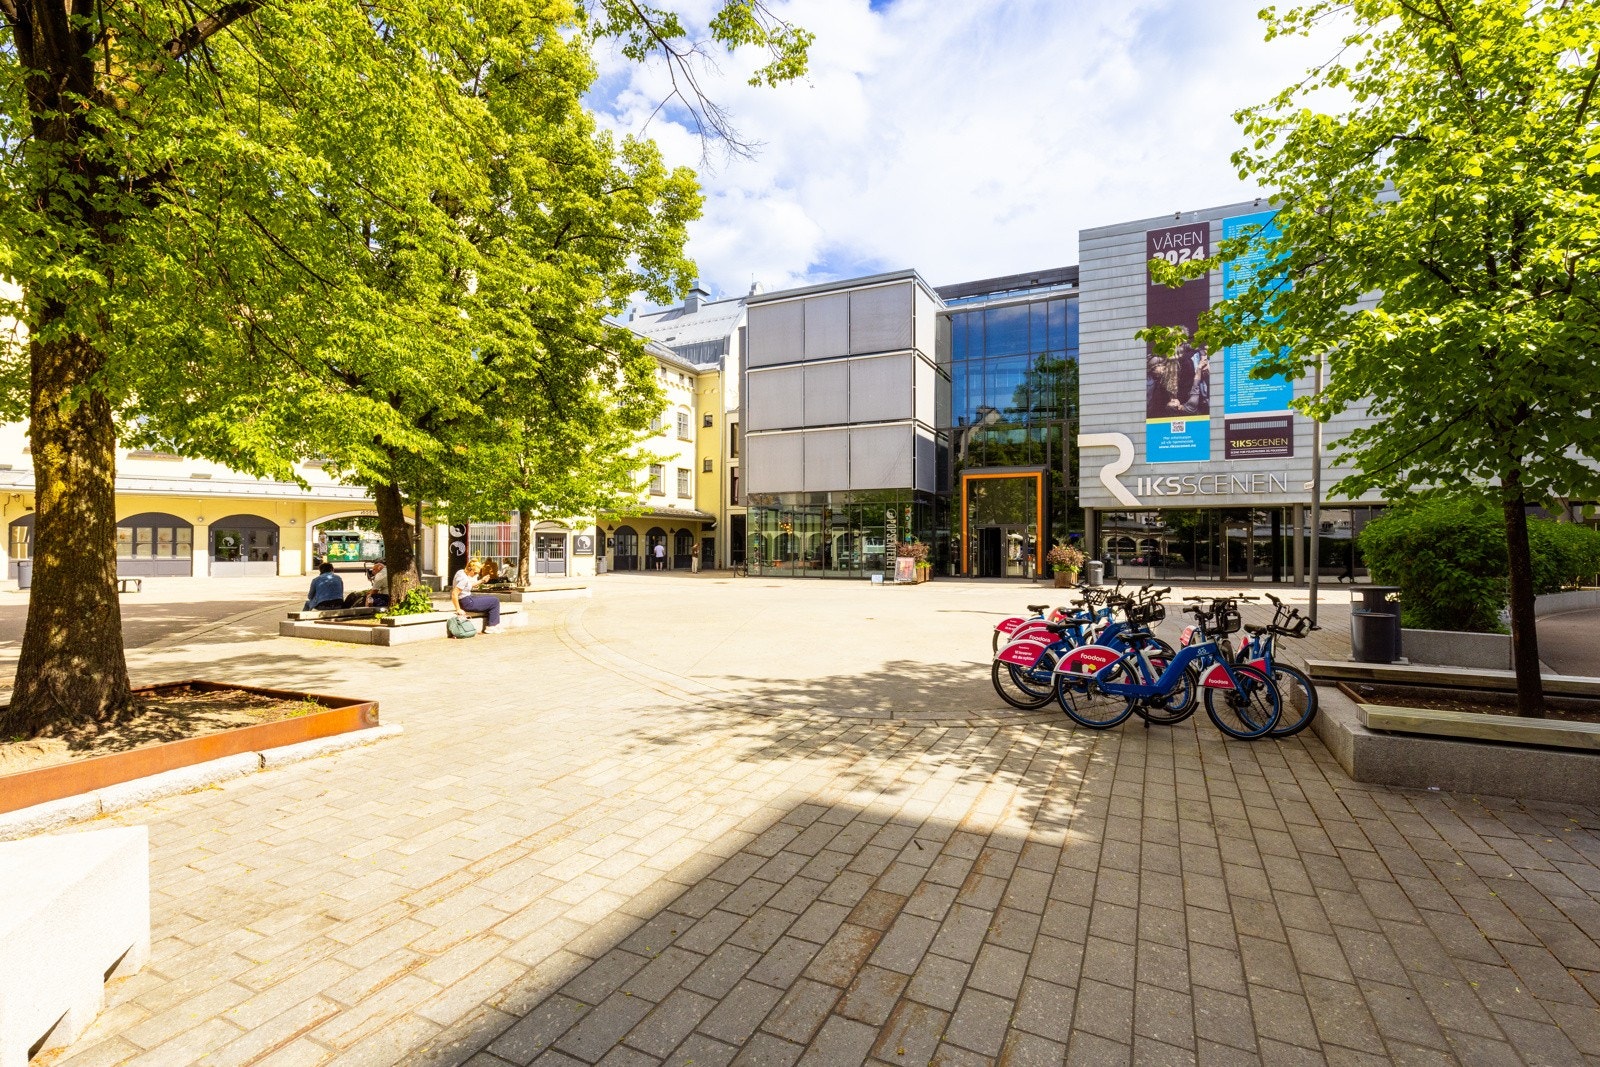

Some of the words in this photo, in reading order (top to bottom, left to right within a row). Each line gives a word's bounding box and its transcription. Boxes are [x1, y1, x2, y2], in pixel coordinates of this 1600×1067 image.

[1152, 230, 1203, 250] VÅREN
[1230, 438, 1288, 448] RIKSSCENEN
[1029, 634, 1051, 642] foodora
[1080, 652, 1107, 663] foodora
